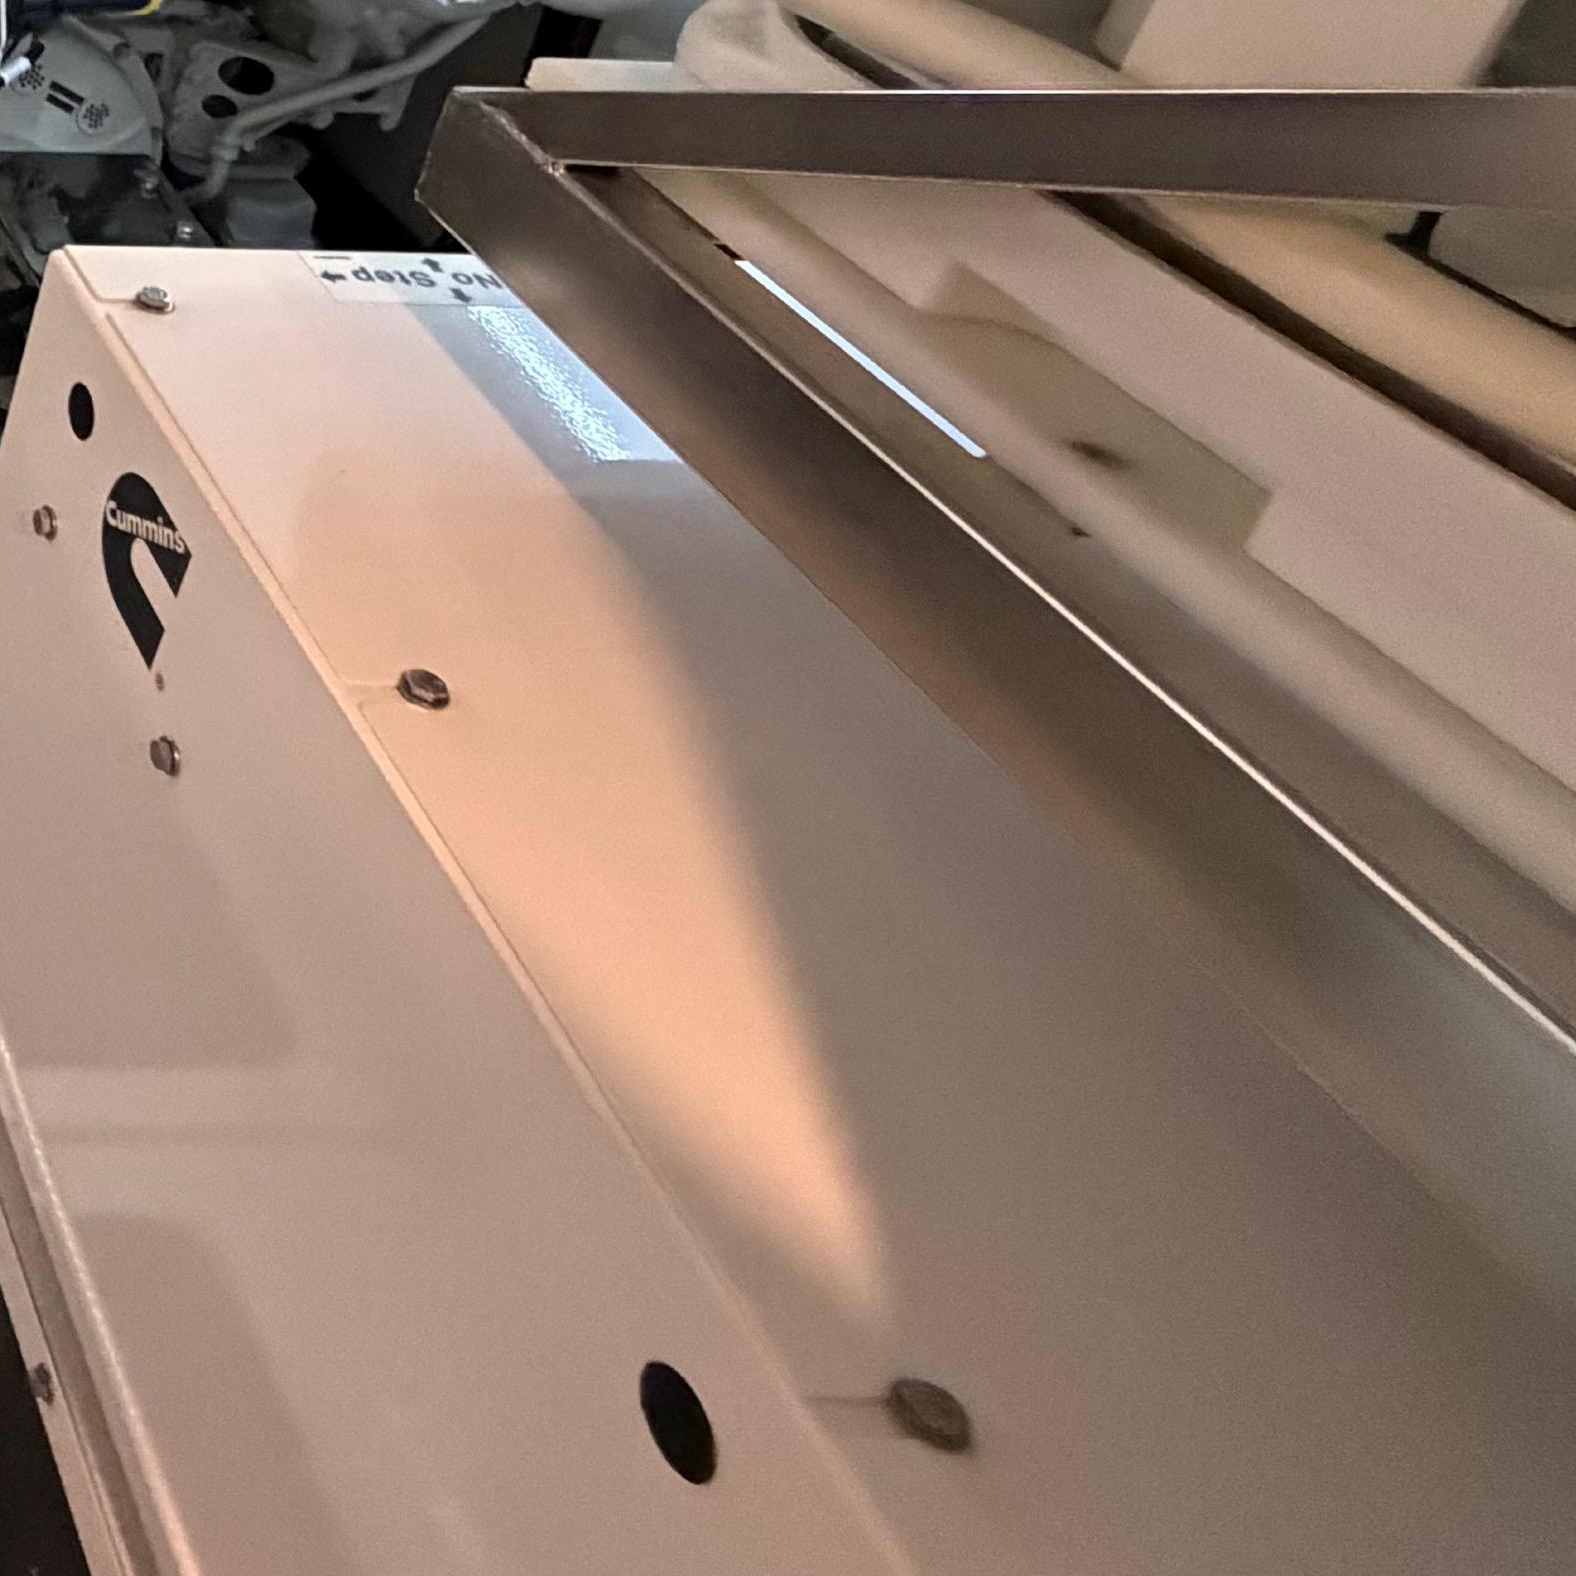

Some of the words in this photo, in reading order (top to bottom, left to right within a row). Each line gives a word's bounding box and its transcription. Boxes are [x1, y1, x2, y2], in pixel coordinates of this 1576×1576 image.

[351, 266, 438, 288] Step
[452, 273, 504, 290] No
[106, 500, 185, 555] Cummins
